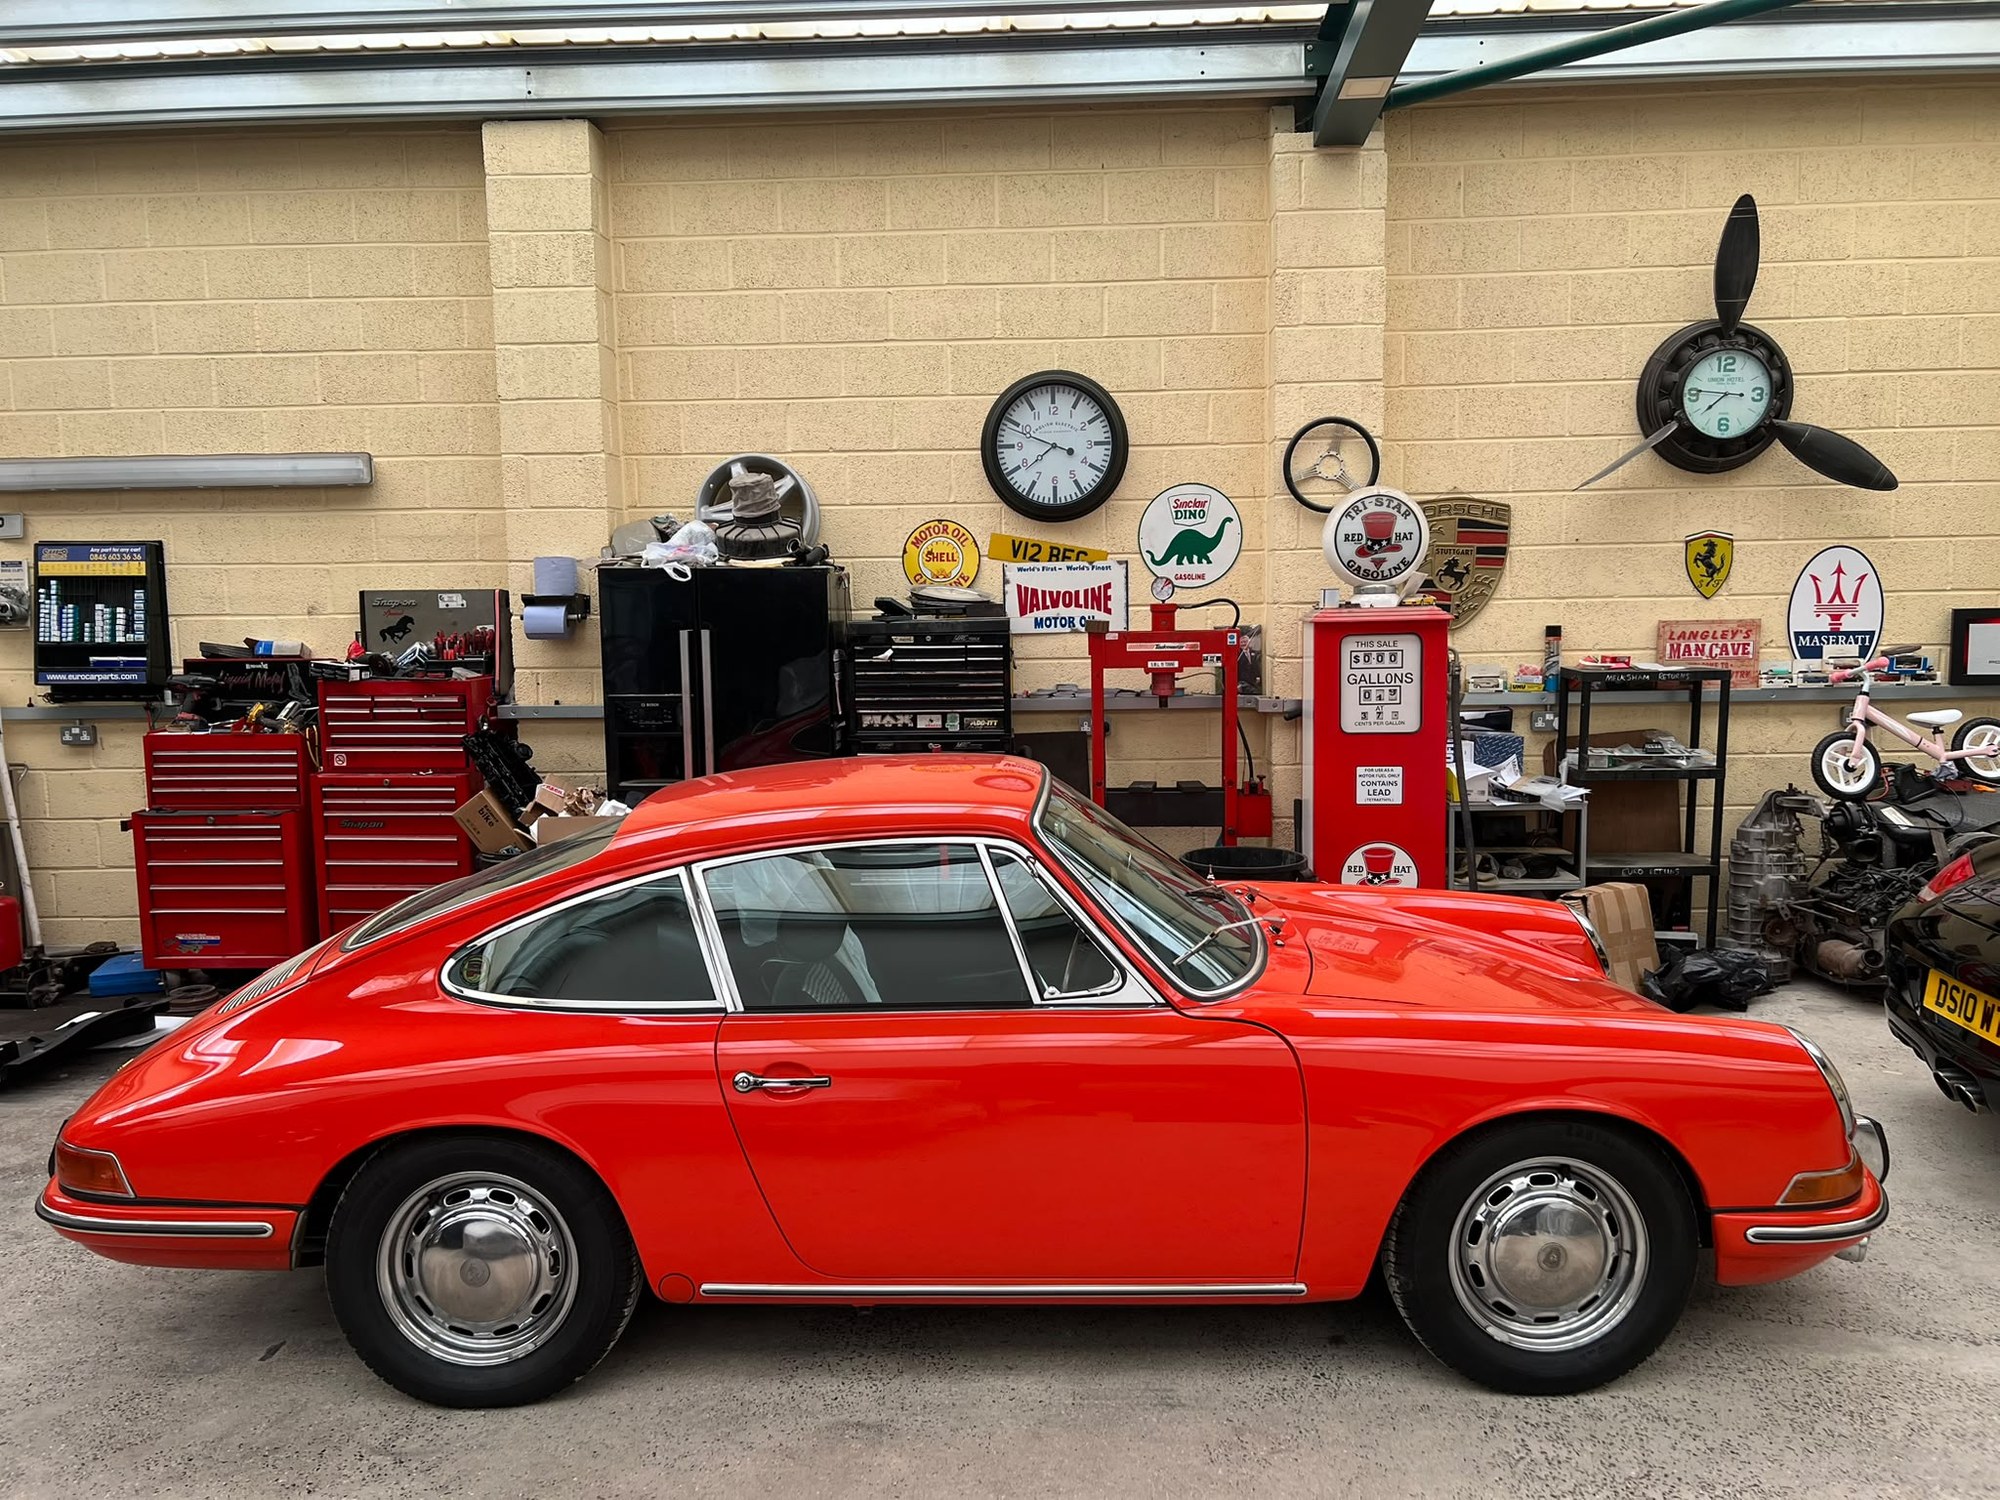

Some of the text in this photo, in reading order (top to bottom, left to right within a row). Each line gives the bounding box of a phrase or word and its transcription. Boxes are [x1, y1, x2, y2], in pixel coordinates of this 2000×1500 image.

[1716, 356, 1736, 372] 12
[1687, 387, 1700, 402] 9
[1751, 386, 1764, 402] 3
[1033, 411, 1040, 421] 11
[1048, 406, 1059, 416] 12
[1069, 410, 1073, 419] 1
[1021, 424, 1032, 434] 10
[1080, 422, 1087, 431] 2
[1717, 417, 1730, 432] 6
[1017, 441, 1024, 451] 9
[1086, 440, 1093, 449] 3
[1021, 458, 1029, 468] 8
[1080, 456, 1089, 465] 4
[1036, 471, 1042, 480] 7
[1069, 470, 1076, 479] 5
[1052, 476, 1058, 485] 6
[1172, 498, 1208, 509] Sinclair
[1174, 509, 1206, 520] DINO
[1344, 497, 1412, 522] TRI-STAR
[1423, 503, 1508, 519] ORSCHE
[910, 524, 969, 549] MOTOR OIL
[1343, 532, 1414, 543] RED HAT
[1011, 539, 1043, 562] V12
[1435, 548, 1474, 556] STUTTGART
[925, 552, 957, 563] SHELL
[1346, 556, 1410, 580] GASOLINE
[372, 597, 417, 608] Snap-on
[1016, 582, 1112, 618] VALVOLINE
[1034, 616, 1076, 629] MOTOR
[1668, 629, 1753, 641] LANGLEY'S
[1798, 635, 1870, 646] MASERATI
[1668, 642, 1751, 659] MAN CAVE
[46, 673, 138, 682] www.eurocarparts.com
[1347, 672, 1414, 685] GALLONS
[1367, 789, 1391, 797] LEAD
[478, 808, 494, 828] bike
[1347, 865, 1412, 874] RED HAT
[1935, 977, 1978, 1023] DS10
